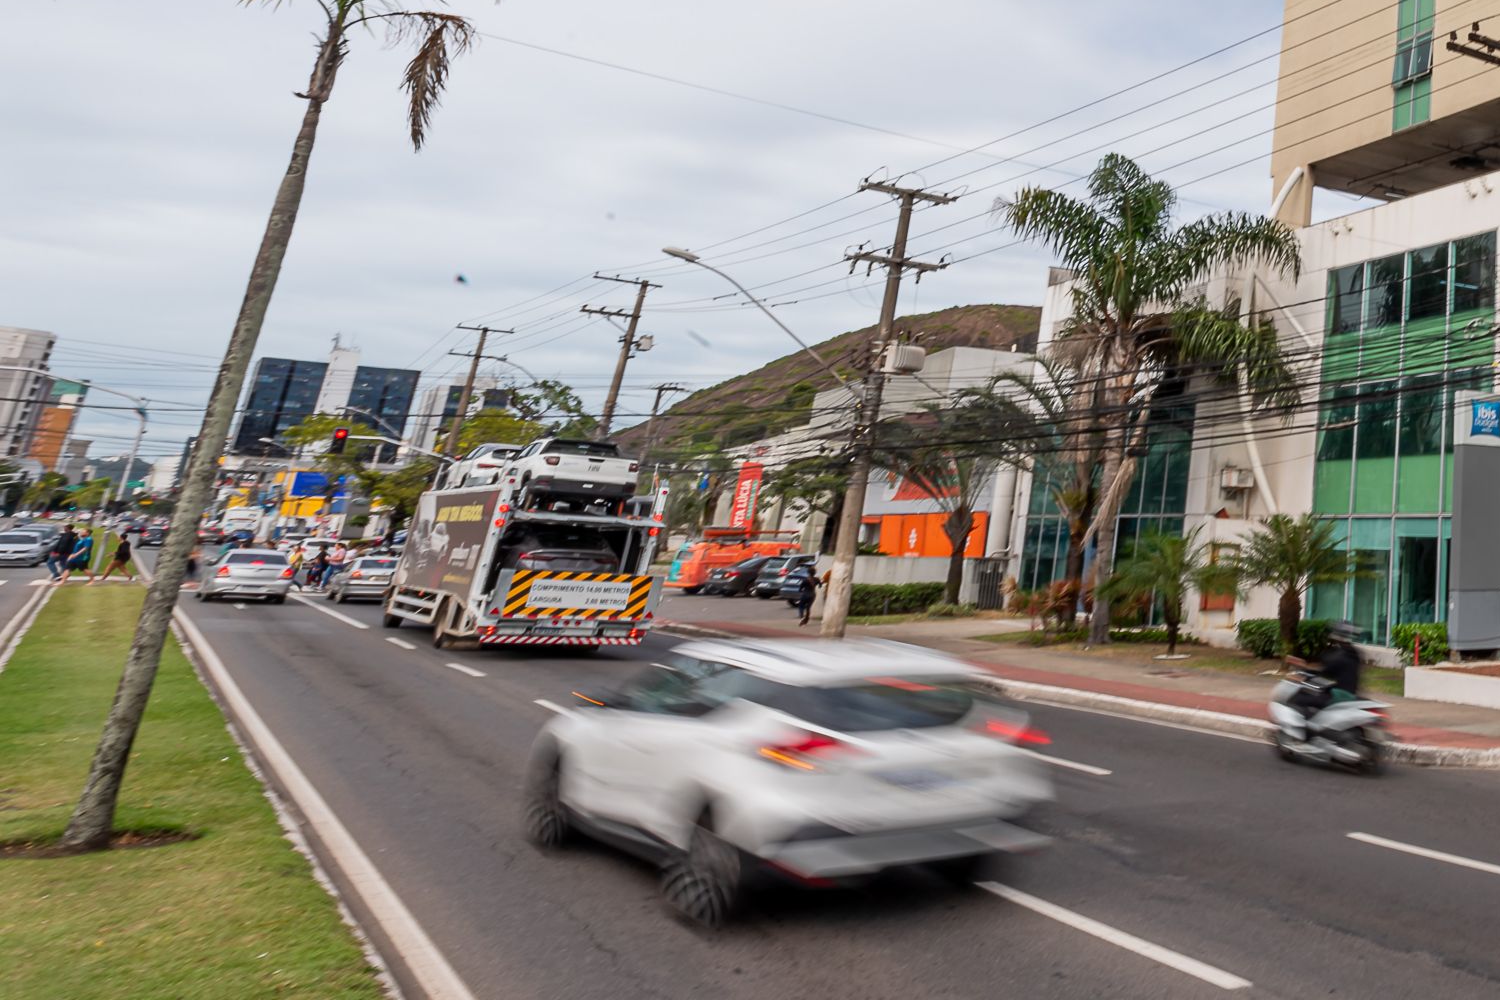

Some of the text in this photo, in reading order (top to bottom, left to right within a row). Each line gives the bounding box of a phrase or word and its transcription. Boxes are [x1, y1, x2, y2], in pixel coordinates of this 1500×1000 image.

[1478, 405, 1497, 420] ibis
[1474, 416, 1499, 428] budget
[532, 583, 584, 593] COMPRIMENTO
[603, 587, 630, 595] METROS
